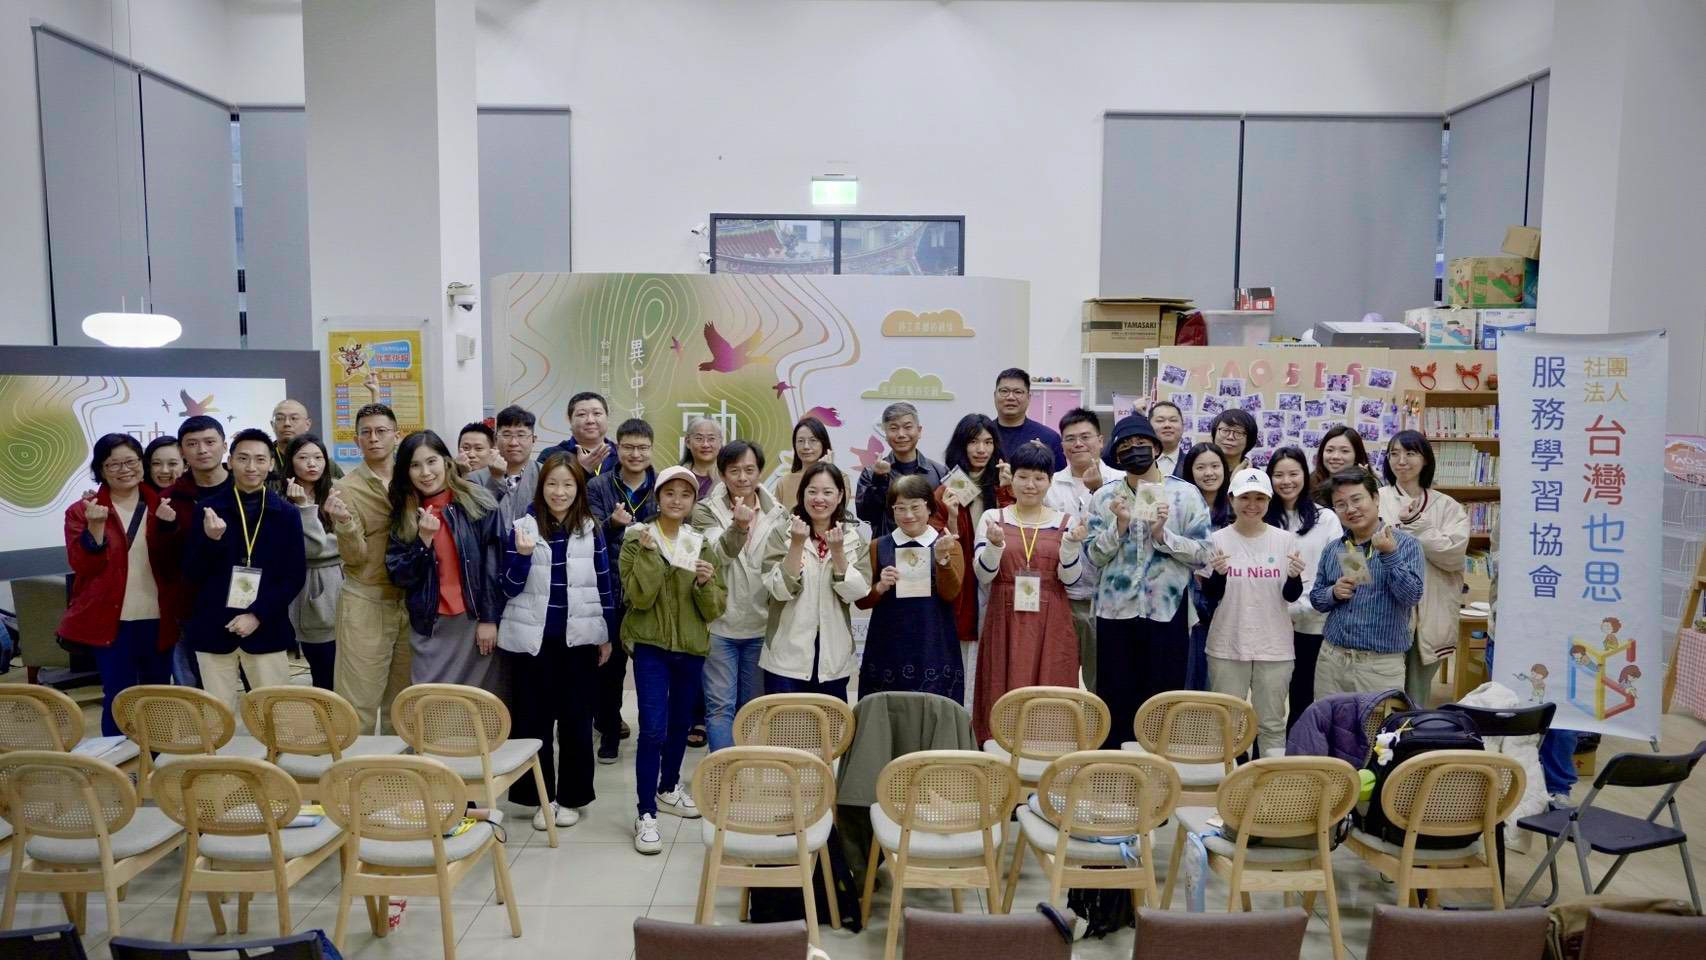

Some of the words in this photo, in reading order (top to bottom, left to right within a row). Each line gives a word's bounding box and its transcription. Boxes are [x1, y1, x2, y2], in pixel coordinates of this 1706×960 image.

[1123, 321, 1157, 330] YAMASAKI
[1583, 356, 1628, 378] 社團
[1583, 381, 1629, 403] 法人
[1528, 356, 1567, 599] 服務學習協會
[1581, 413, 1627, 603] 台灣也思
[1247, 565, 1281, 579] Nian
